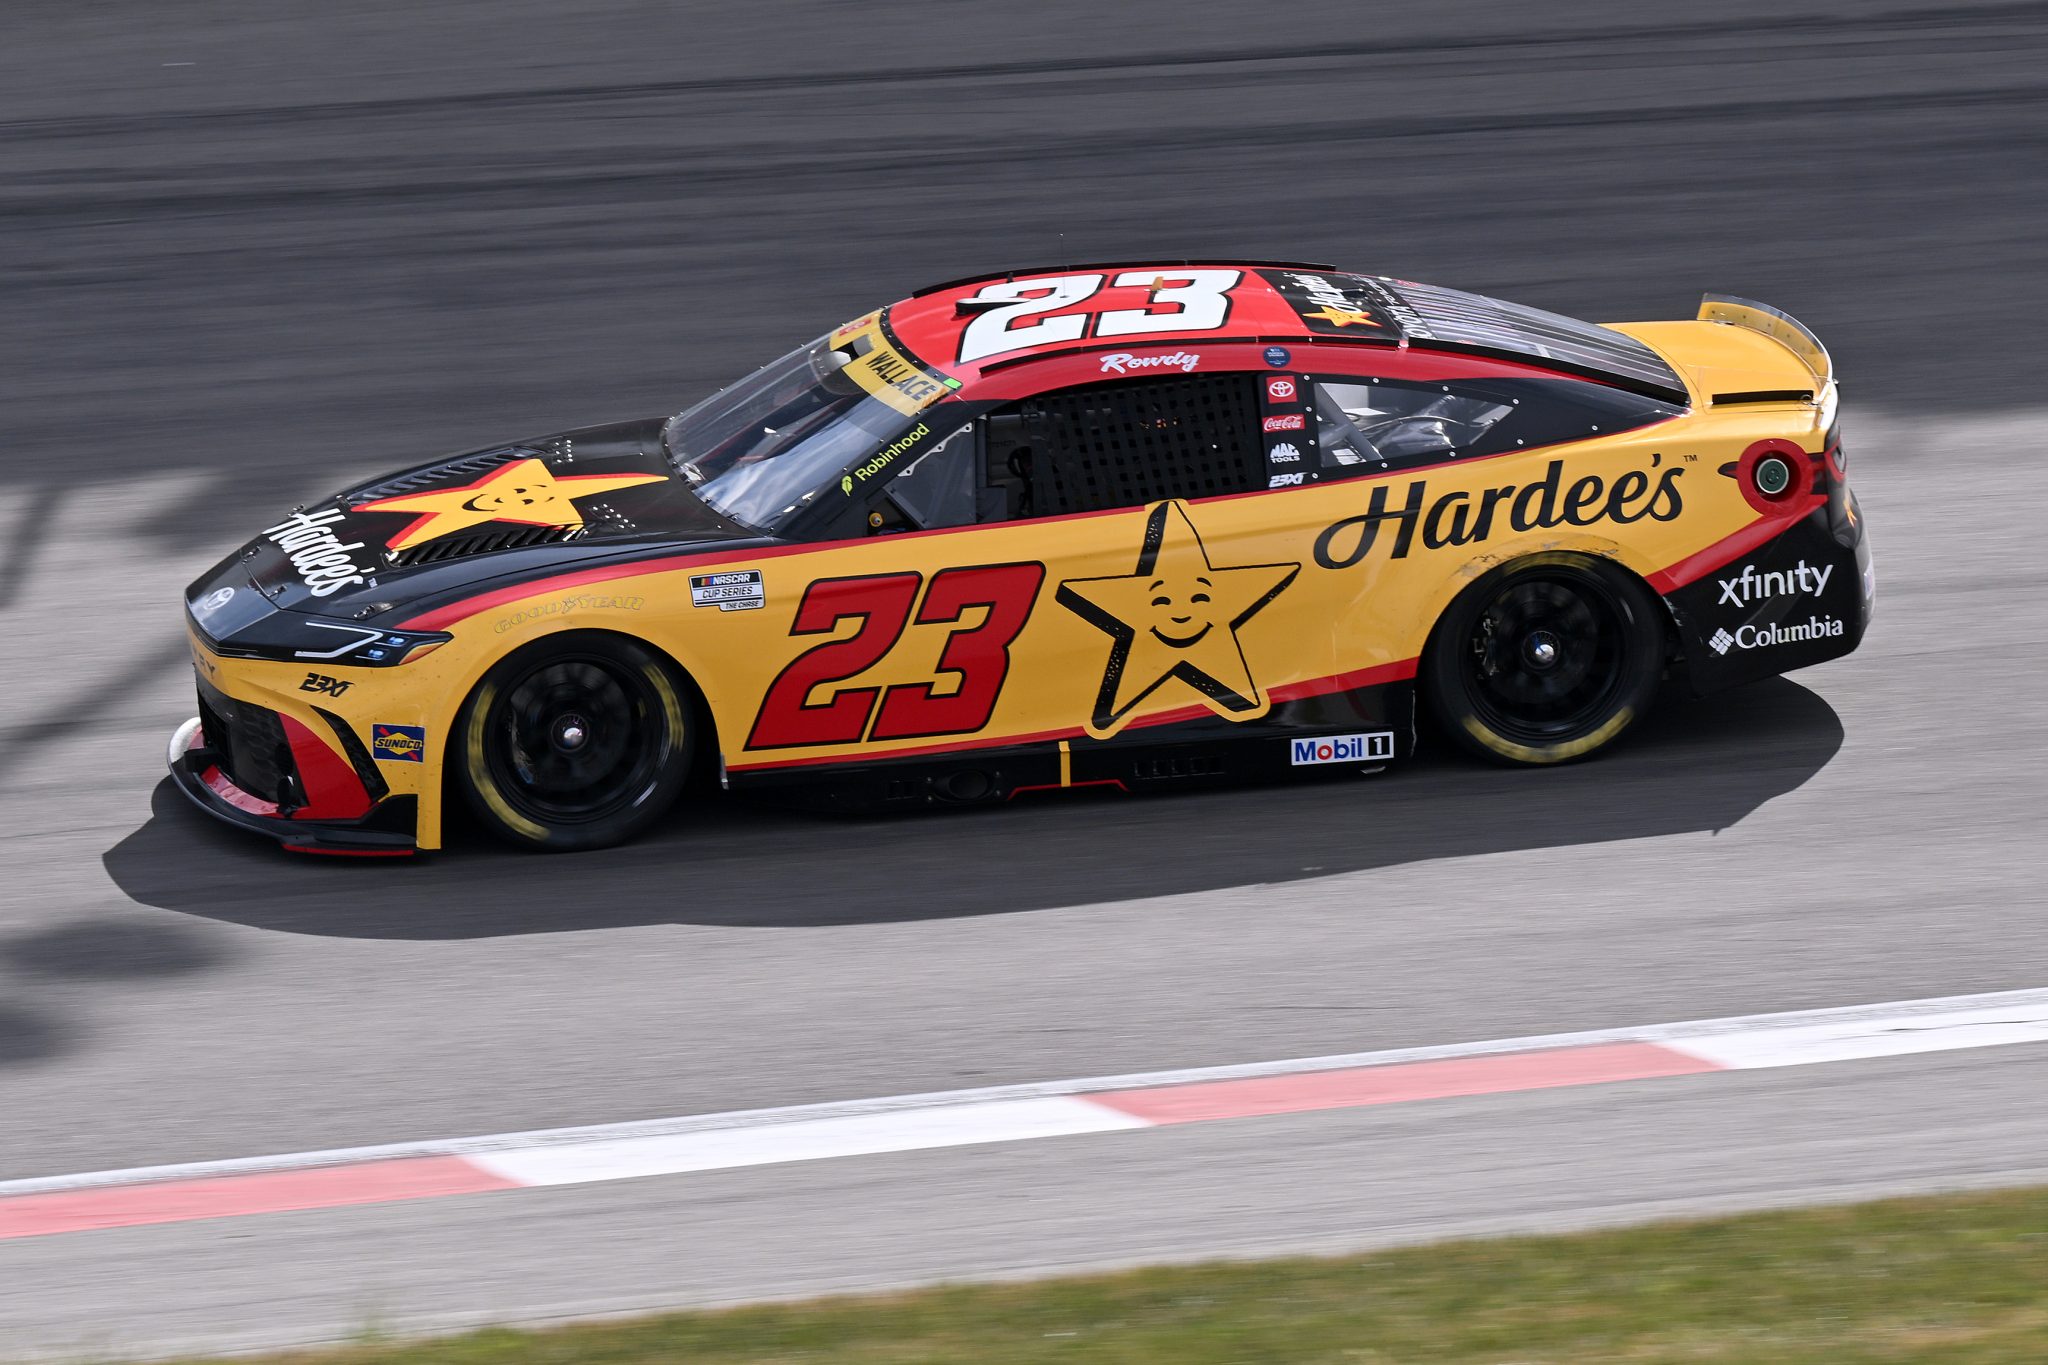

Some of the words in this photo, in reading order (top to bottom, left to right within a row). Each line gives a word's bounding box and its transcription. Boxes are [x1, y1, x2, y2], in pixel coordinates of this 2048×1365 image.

[953, 269, 1248, 364] 23
[865, 351, 937, 401] WALLACE
[1099, 351, 1201, 374] Rowdy
[854, 422, 930, 482] Robinhood
[1270, 442, 1300, 458] MAC
[1271, 455, 1301, 464] TOOLS
[1312, 453, 1686, 570] Hardee's
[261, 508, 376, 597] Hardee's
[703, 589, 720, 599] CUP
[721, 587, 753, 597] SERIES
[713, 574, 750, 585] NASCAR
[1718, 559, 1833, 608] xfinity
[738, 601, 759, 609] CHASE
[1735, 615, 1843, 649] Columbia
[743, 560, 1046, 752] 23
[376, 738, 422, 751] SUNOCO
[1295, 738, 1363, 762] Mobil
[1373, 737, 1383, 755] 1
